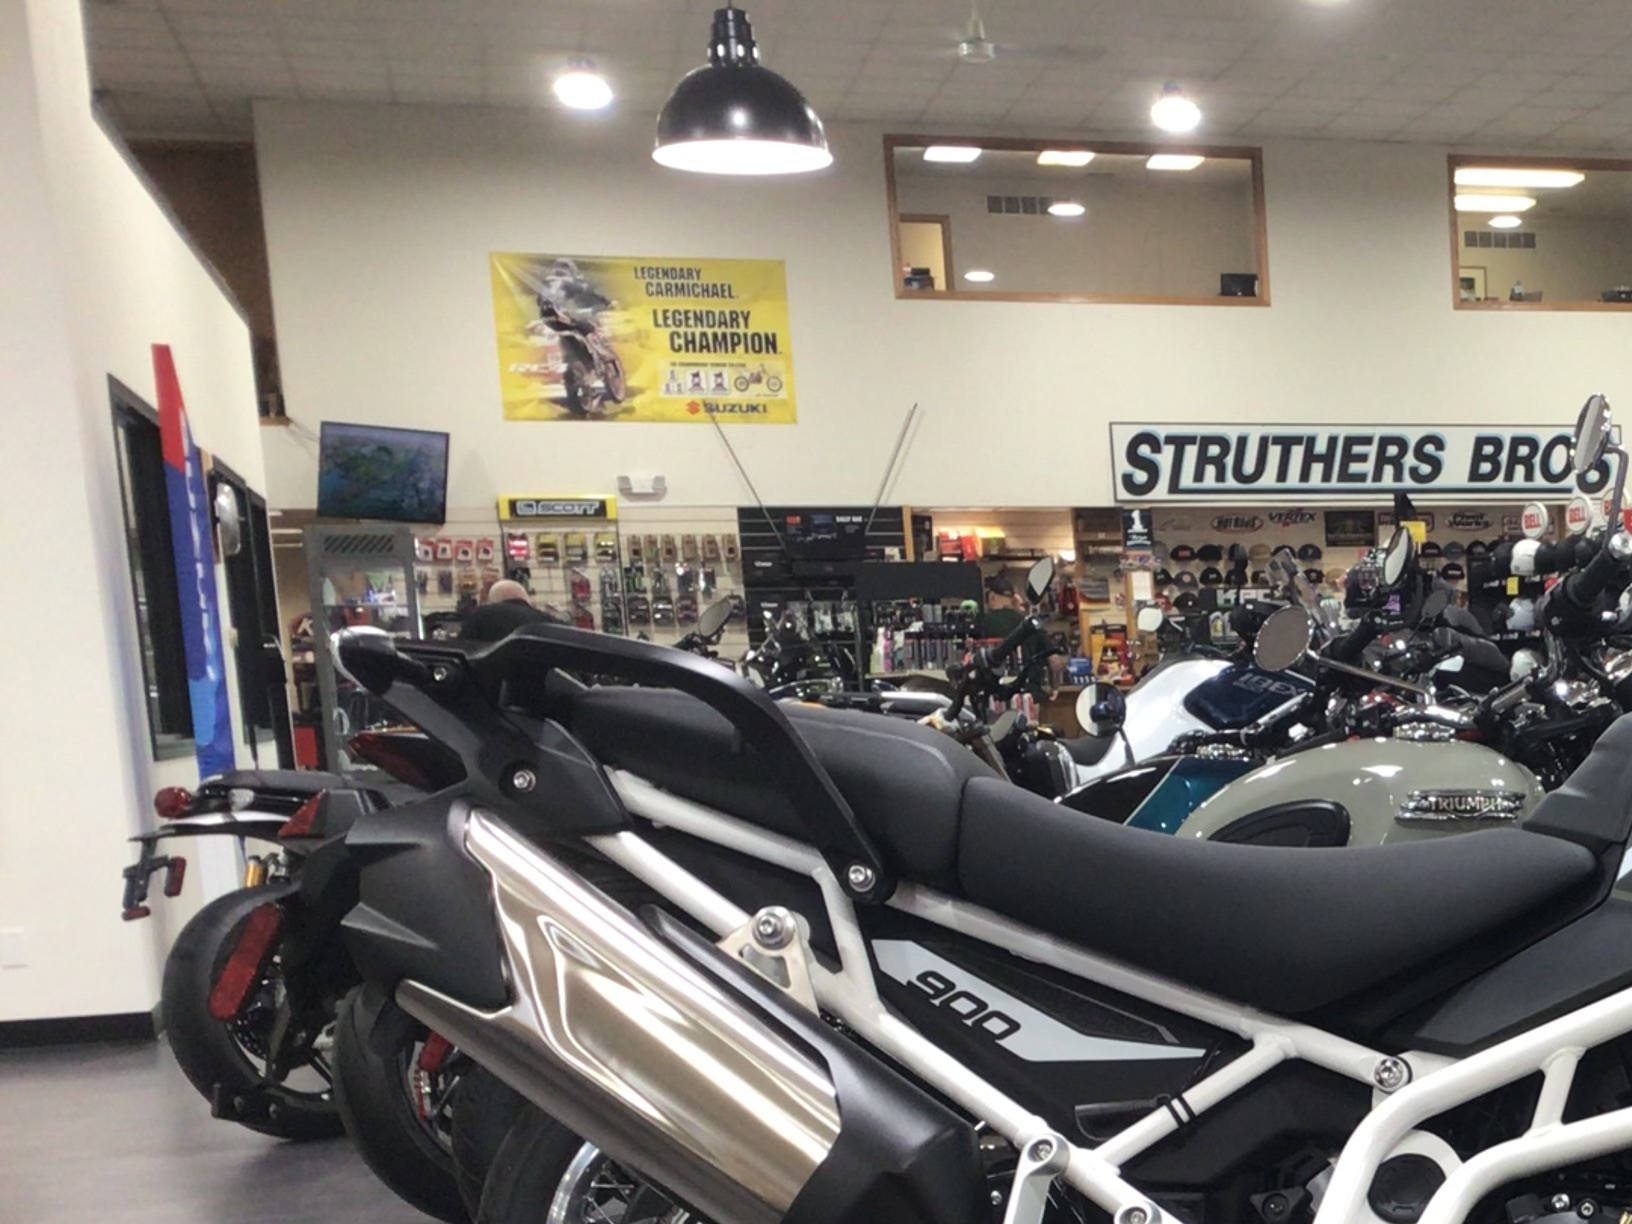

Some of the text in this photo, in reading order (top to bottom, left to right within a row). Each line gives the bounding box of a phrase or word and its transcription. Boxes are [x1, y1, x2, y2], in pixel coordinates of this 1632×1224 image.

[634, 266, 701, 281] LEGENDARY
[645, 281, 735, 299] CARMICHAEL
[653, 308, 751, 329] LEGENDARY
[669, 331, 778, 354] CHAMPION
[703, 403, 768, 414] SUZUKI
[1121, 430, 1447, 496] STRUTHERS
[538, 501, 600, 514] SCOTT
[1569, 506, 1586, 525] BELL
[1524, 513, 1541, 530] BELL
[1430, 796, 1502, 812] TRIUMPH
[906, 970, 1022, 1042] 900
